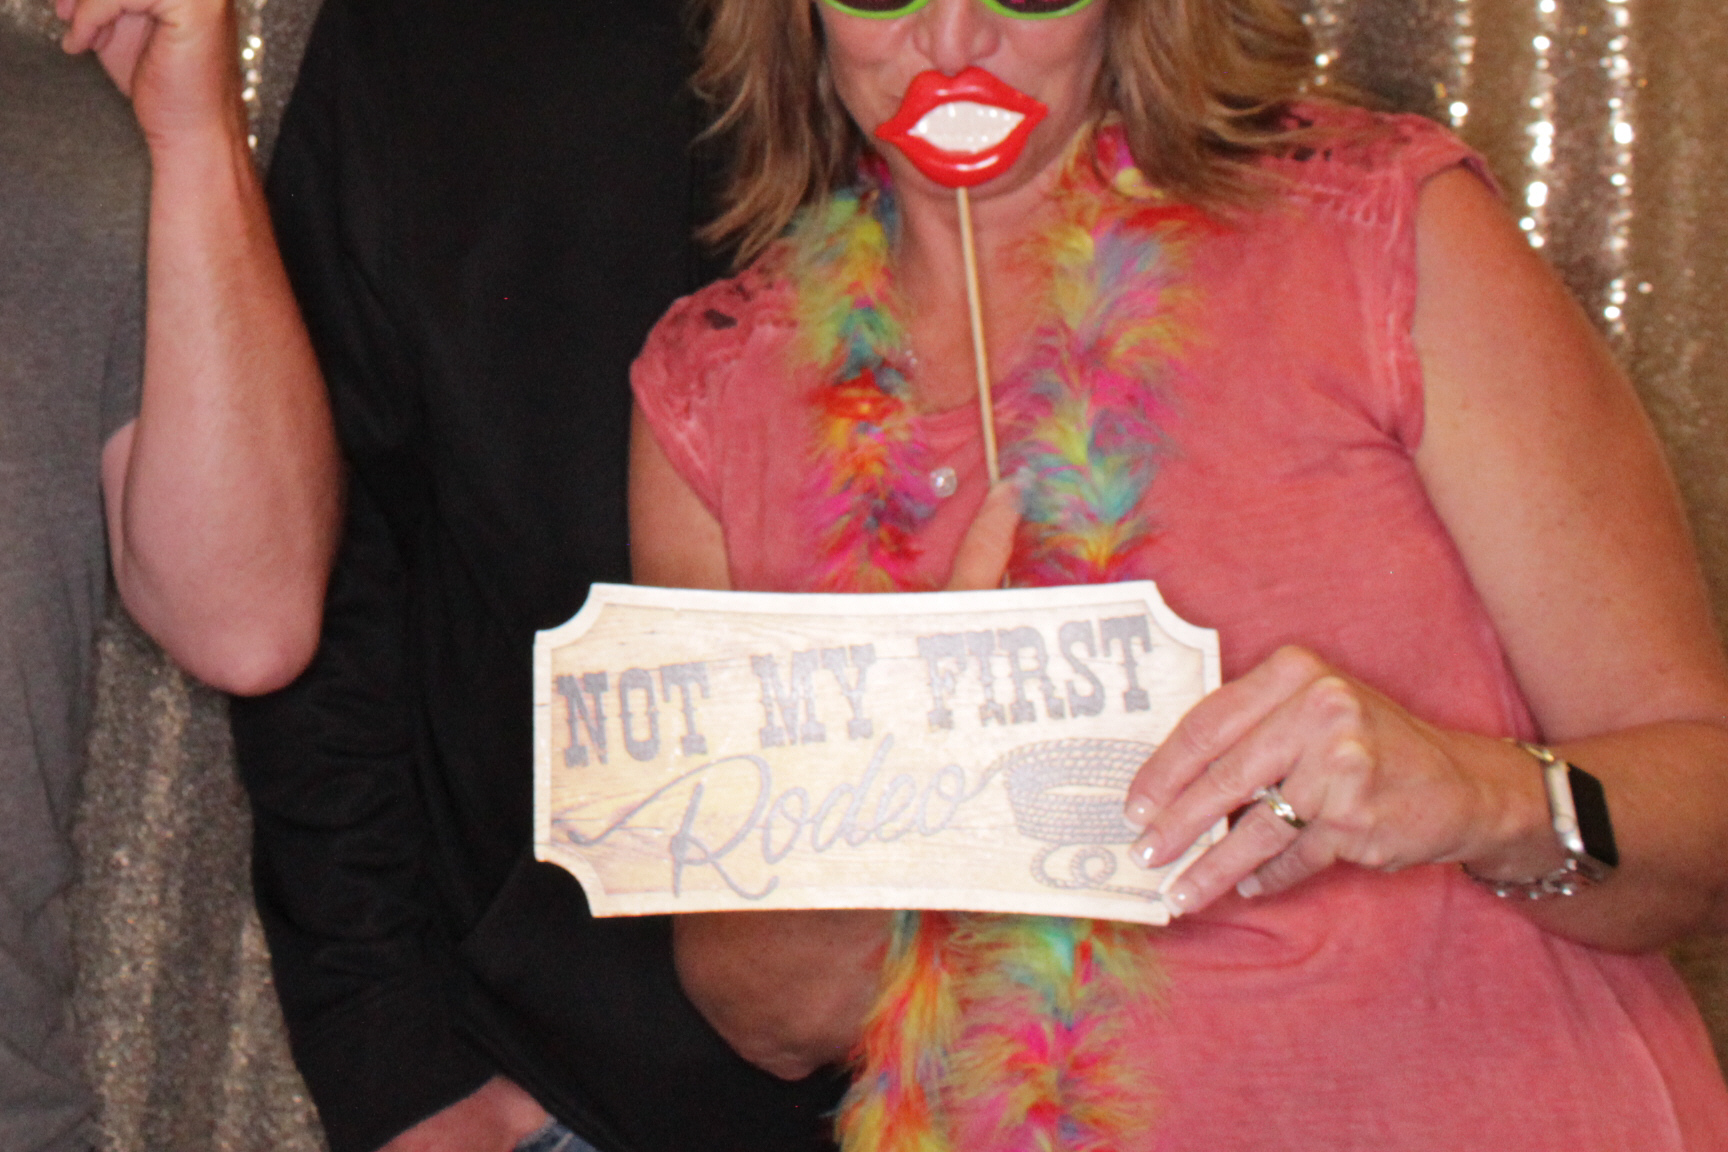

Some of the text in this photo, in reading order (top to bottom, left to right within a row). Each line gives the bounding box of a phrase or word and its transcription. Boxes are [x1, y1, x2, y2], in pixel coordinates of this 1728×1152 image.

[556, 614, 1154, 768] NOT MY FIRST
[567, 735, 969, 901] Rodeo
